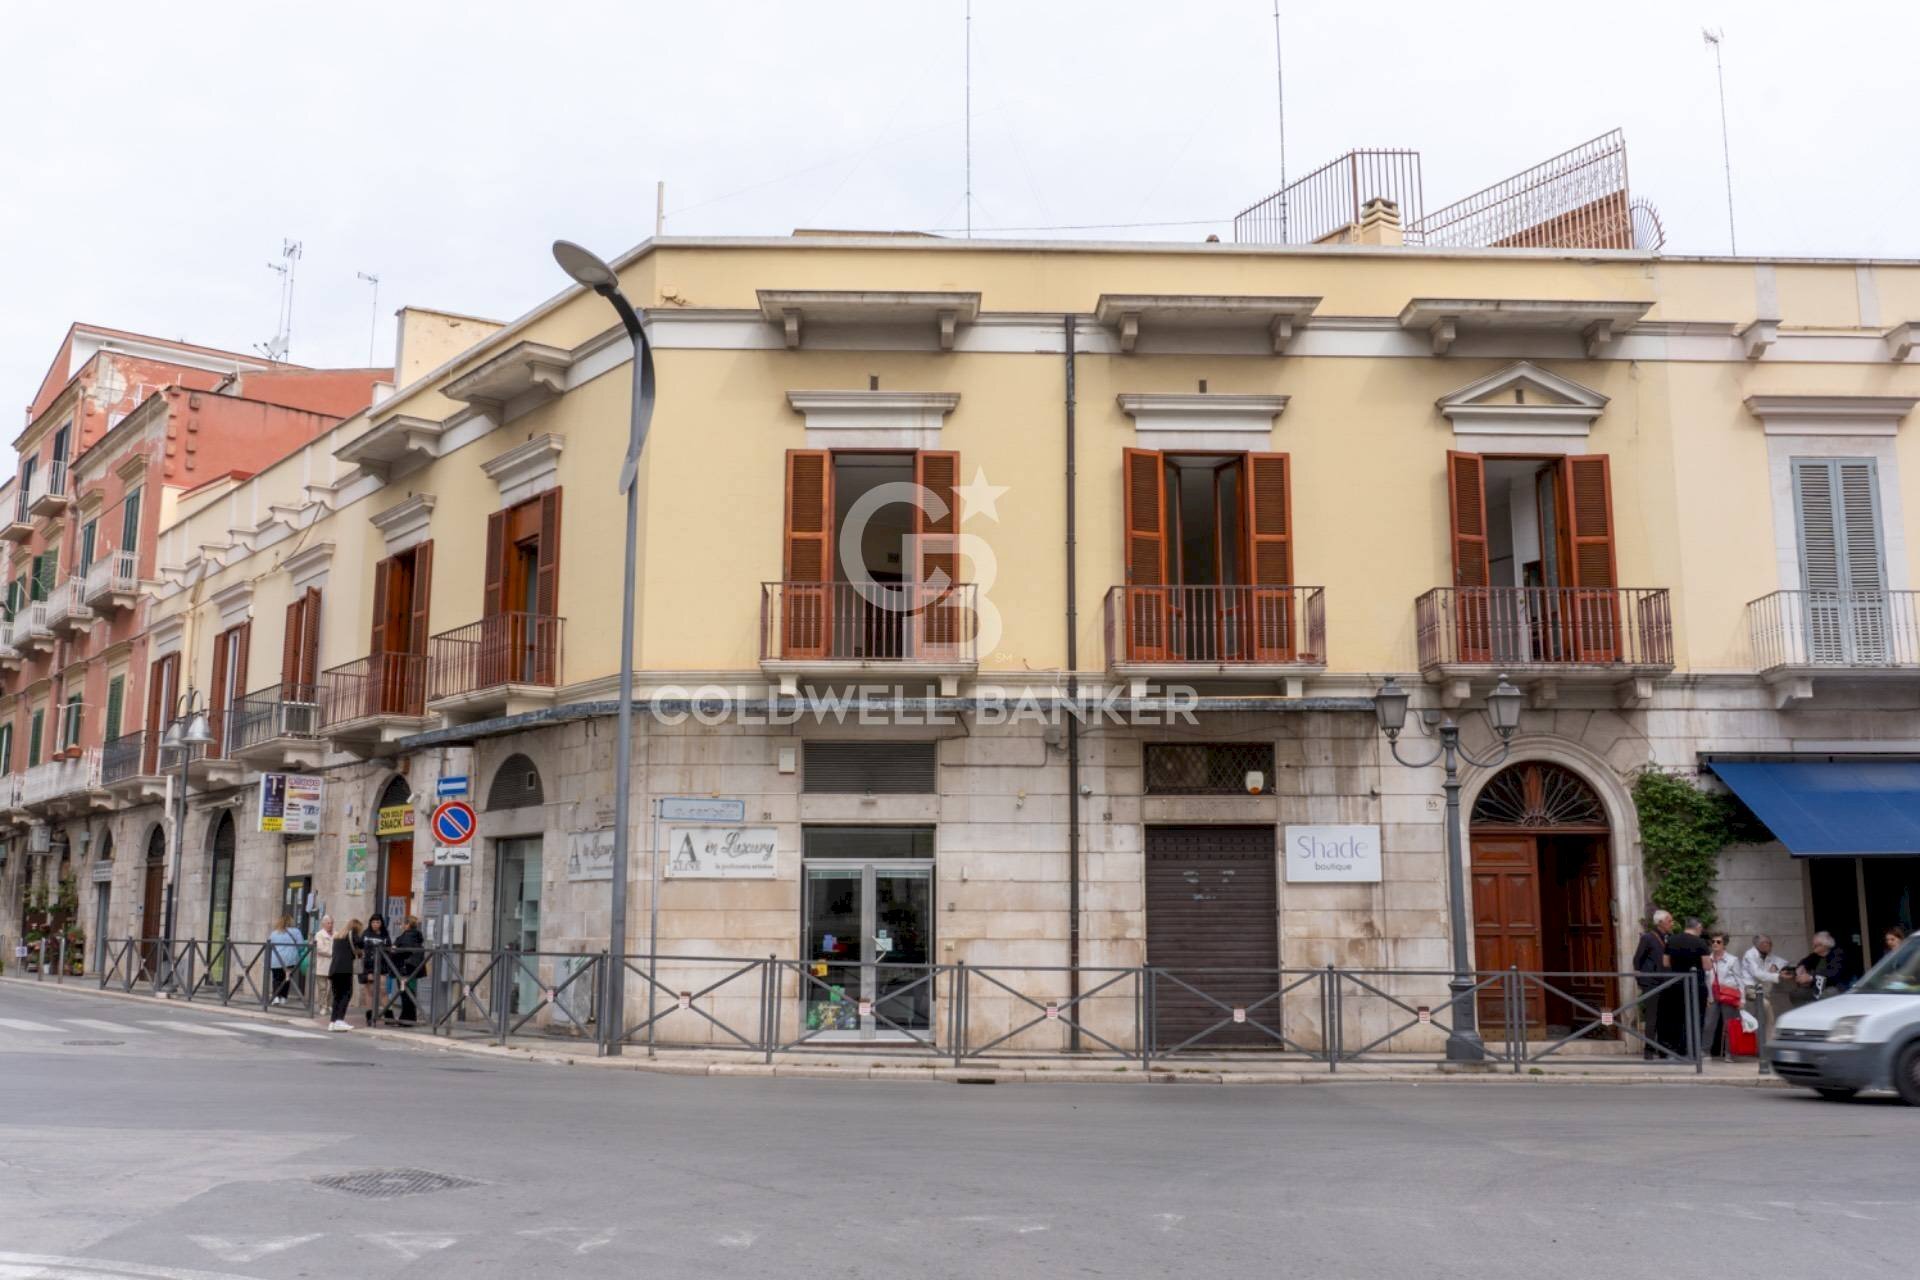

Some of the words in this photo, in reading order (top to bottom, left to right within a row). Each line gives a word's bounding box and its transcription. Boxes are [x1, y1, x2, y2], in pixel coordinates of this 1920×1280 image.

[380, 818, 402, 830] SNACK
[676, 832, 697, 862] A
[720, 832, 775, 861] Luxury
[1297, 835, 1368, 859] Shade
[1314, 862, 1352, 871] boutique
